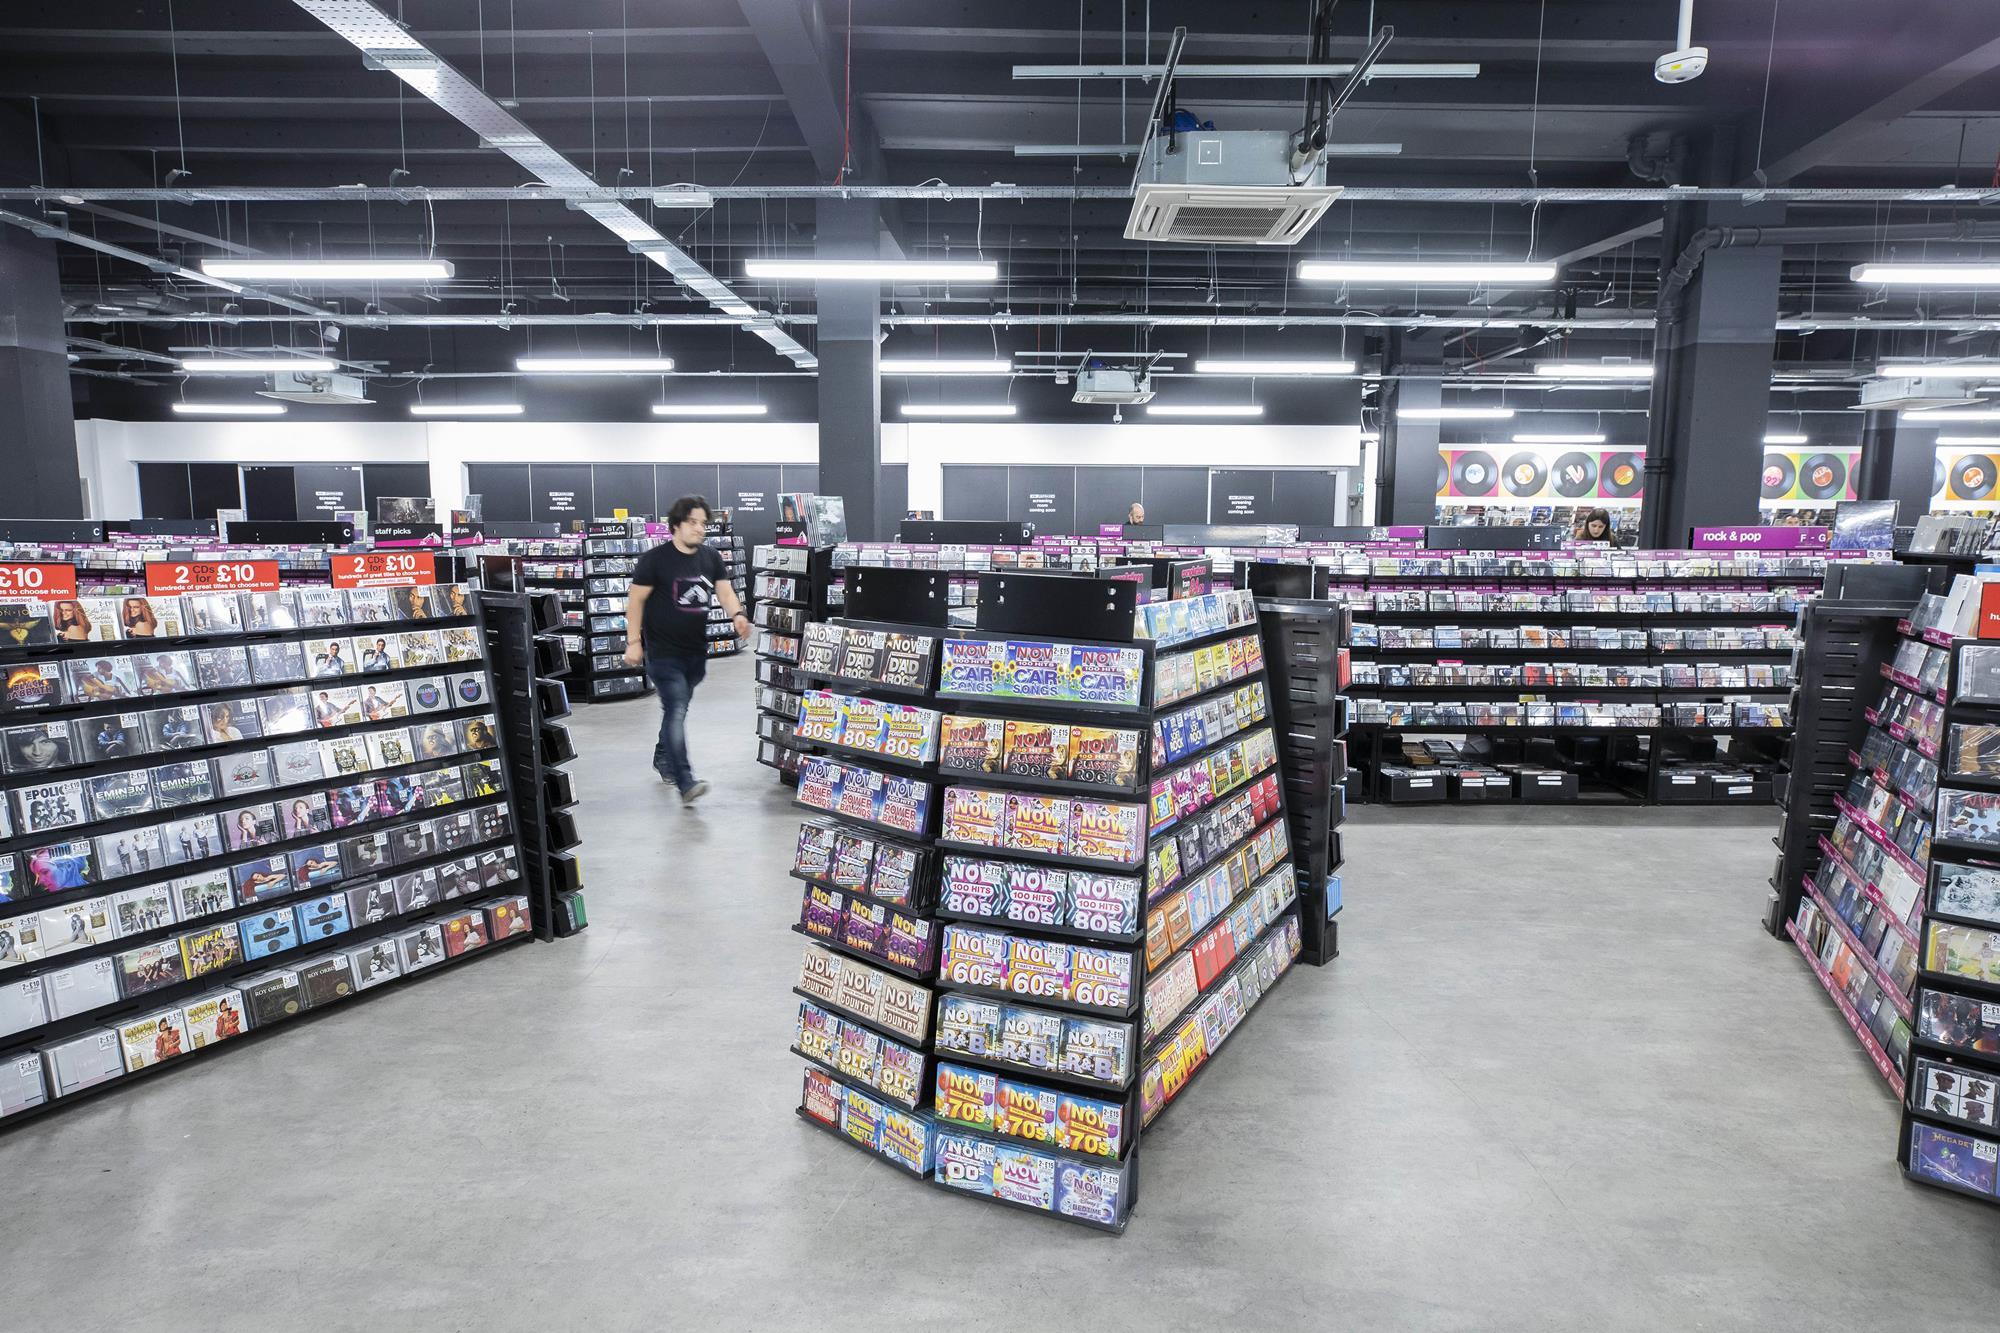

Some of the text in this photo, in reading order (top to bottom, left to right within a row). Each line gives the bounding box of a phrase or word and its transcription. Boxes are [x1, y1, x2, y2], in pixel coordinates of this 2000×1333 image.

[1023, 529, 1030, 538] D
[1534, 534, 1541, 543] E
[1554, 534, 1561, 543] F
[1703, 530, 1762, 543] rock & pop
[1800, 534, 1807, 542] F
[354, 555, 415, 572] 2 CDs £10
[369, 563, 382, 572] for
[175, 564, 254, 584] 2 CDs £10
[195, 573, 212, 583] for
[369, 571, 383, 579] great
[195, 583, 212, 591] great
[806, 646, 833, 662] DAD
[846, 652, 875, 669] DAD
[889, 657, 919, 675] DAD
[952, 667, 993, 682] CAR
[13, 679, 43, 691] BLACK
[1014, 669, 1058, 685] CAR
[1080, 674, 1126, 690] CAR
[7, 686, 53, 700] SABBATH
[951, 681, 993, 693] SONGS
[1013, 684, 1058, 697] SONGS
[1079, 690, 1126, 702] SONGS
[802, 721, 833, 740] 80s
[843, 730, 876, 749] 80s
[949, 723, 987, 741] NOW
[1013, 727, 1052, 747] NOW
[885, 738, 921, 757] 80s
[1079, 735, 1119, 753] NOW
[947, 756, 985, 772] ROCK
[1012, 763, 1050, 779] ROCK
[1077, 769, 1118, 785] ROCK
[803, 784, 832, 798] POWER
[843, 792, 872, 809] POWER
[954, 799, 994, 820] NOW
[885, 803, 916, 820] POWER
[1016, 806, 1058, 827] NOW
[1082, 812, 1125, 835] NOW
[953, 883, 992, 894] 100 HITS
[1013, 892, 1053, 903] 100 HITS
[948, 894, 992, 916] 80s
[1008, 903, 1054, 925] 80s
[1079, 900, 1120, 912] 100 HITS
[1074, 912, 1122, 934] 80s
[847, 935, 873, 952] PARTY
[805, 953, 837, 979] NOW
[888, 951, 916, 968] PARTY
[307, 970, 319, 979] ROY
[843, 970, 877, 995] NOW
[951, 962, 993, 986] 60s
[255, 988, 267, 997] ROY
[801, 977, 833, 999] COUNTRY
[1013, 972, 1056, 996] 60s
[885, 985, 921, 1014] NOW
[1076, 982, 1120, 1007] 60s
[840, 993, 875, 1017] COUNTRY
[882, 1010, 919, 1035] COUNTRY
[802, 1030, 827, 1051] OLD
[943, 1028, 986, 1055] R&B
[840, 1048, 868, 1070] OLD
[1003, 1039, 1047, 1067] R&B
[1066, 1052, 1112, 1081] R&B
[882, 1067, 912, 1090] OLD
[949, 1099, 986, 1123] 70s
[1008, 1115, 1047, 1142] 70s
[1069, 1130, 1111, 1157] 70s
[1932, 1131, 1974, 1149] MEGADET
[1074, 1178, 1103, 1196] NOW
[1073, 1203, 1102, 1216] BEDTIME
